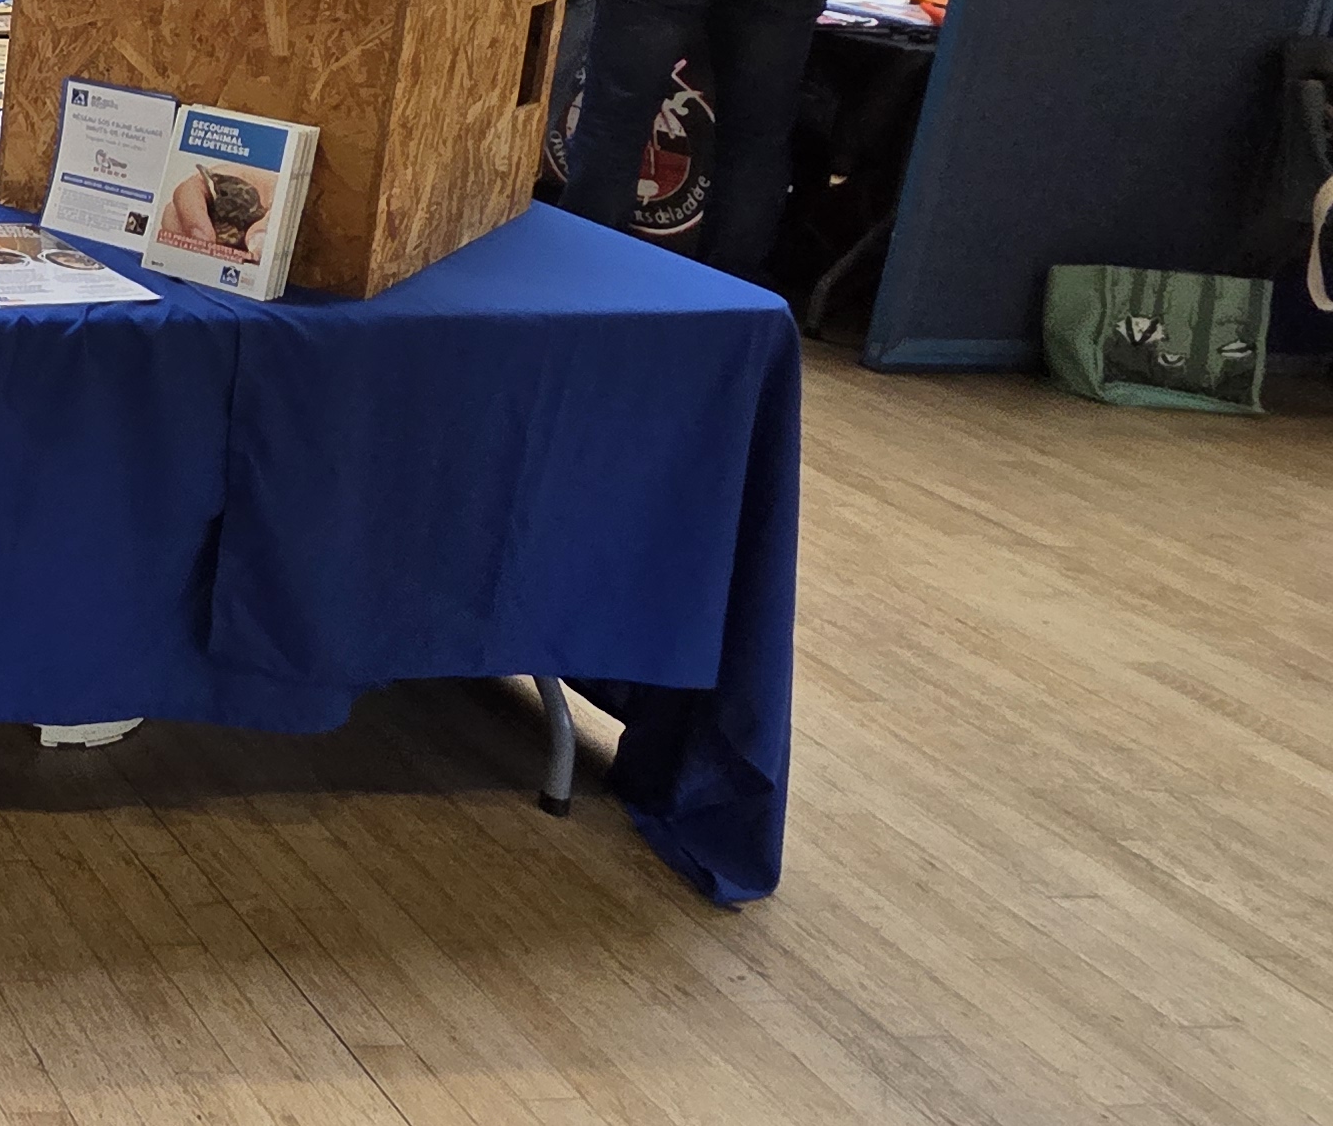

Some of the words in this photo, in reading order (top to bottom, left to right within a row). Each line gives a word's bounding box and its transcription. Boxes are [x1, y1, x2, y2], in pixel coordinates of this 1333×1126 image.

[192, 120, 239, 136] SECOURIR
[188, 137, 202, 146] EN
[191, 129, 204, 138] UN
[205, 132, 243, 146] ANIMAL
